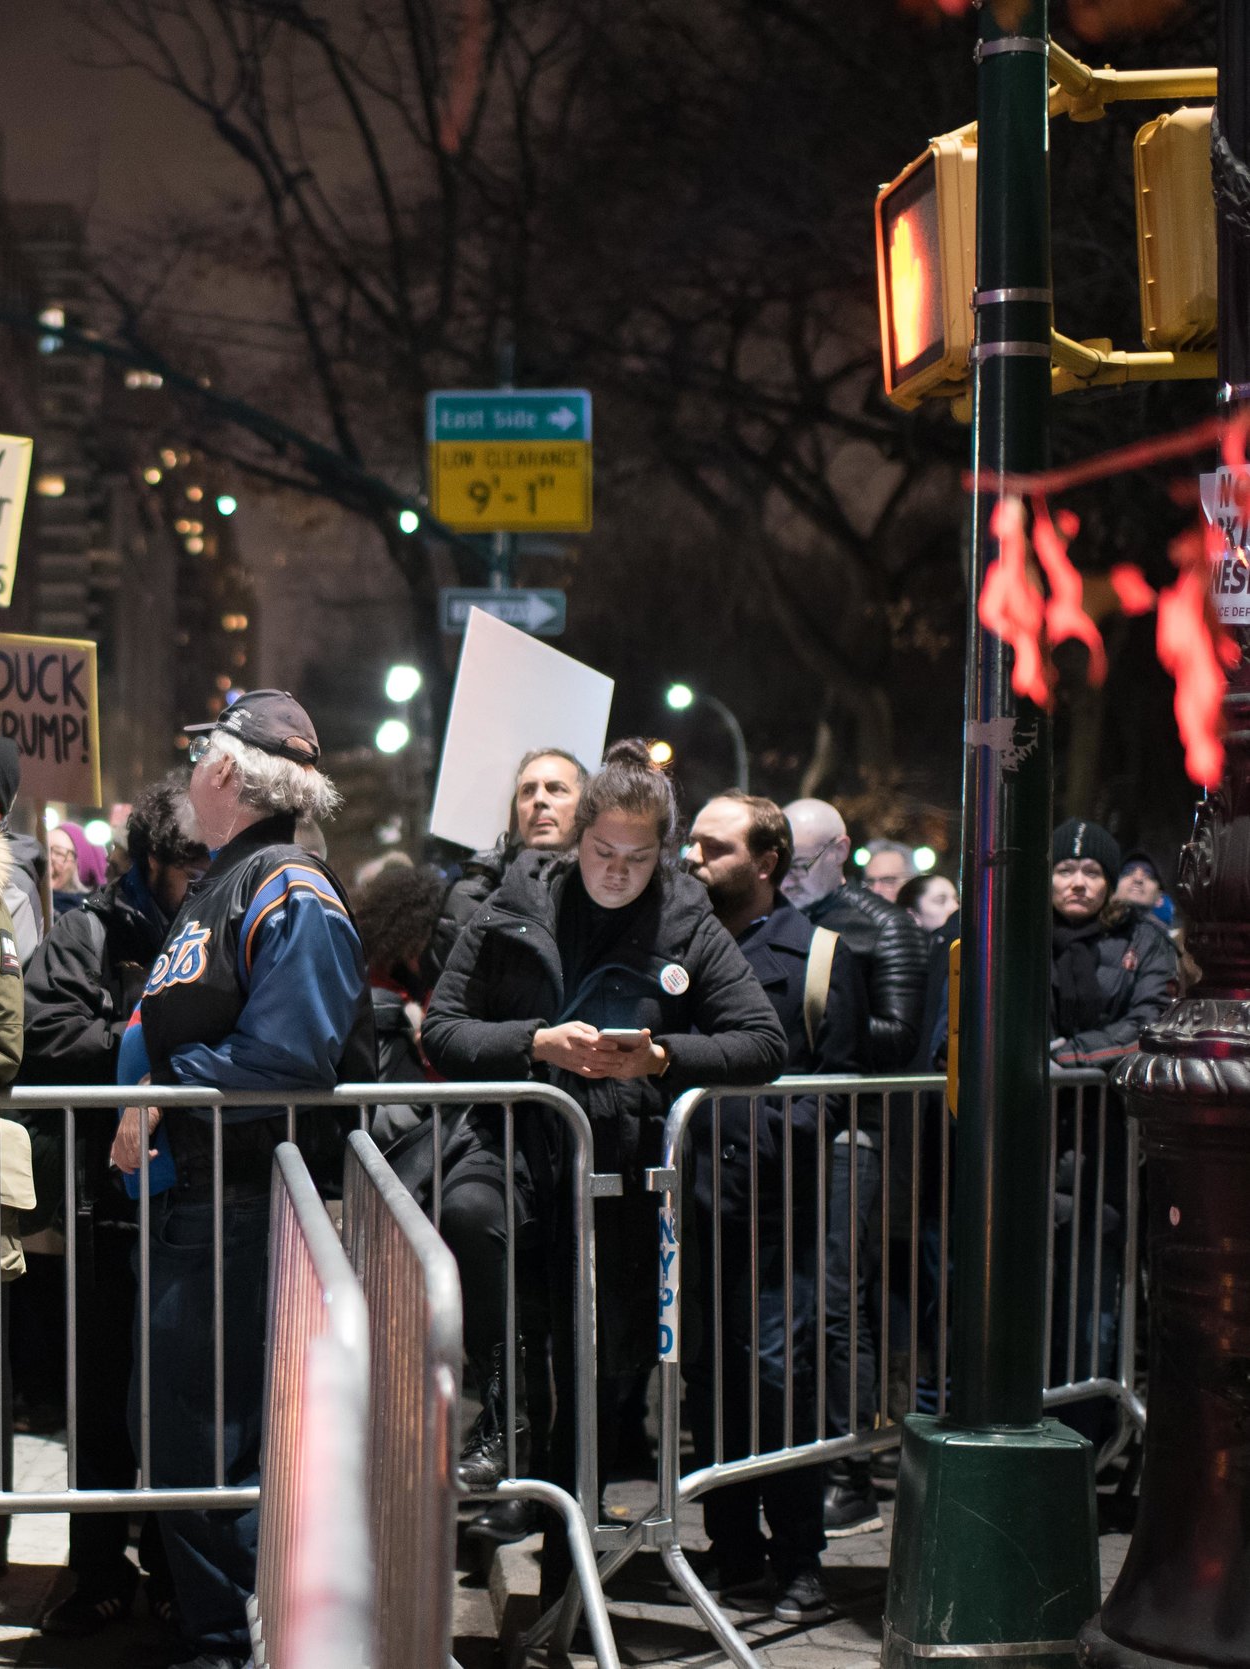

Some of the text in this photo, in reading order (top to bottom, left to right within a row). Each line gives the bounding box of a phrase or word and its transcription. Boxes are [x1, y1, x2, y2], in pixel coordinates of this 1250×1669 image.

[440, 410, 538, 429] East Side
[143, 921, 213, 993] ets
[658, 1213, 676, 1355] NYPD
